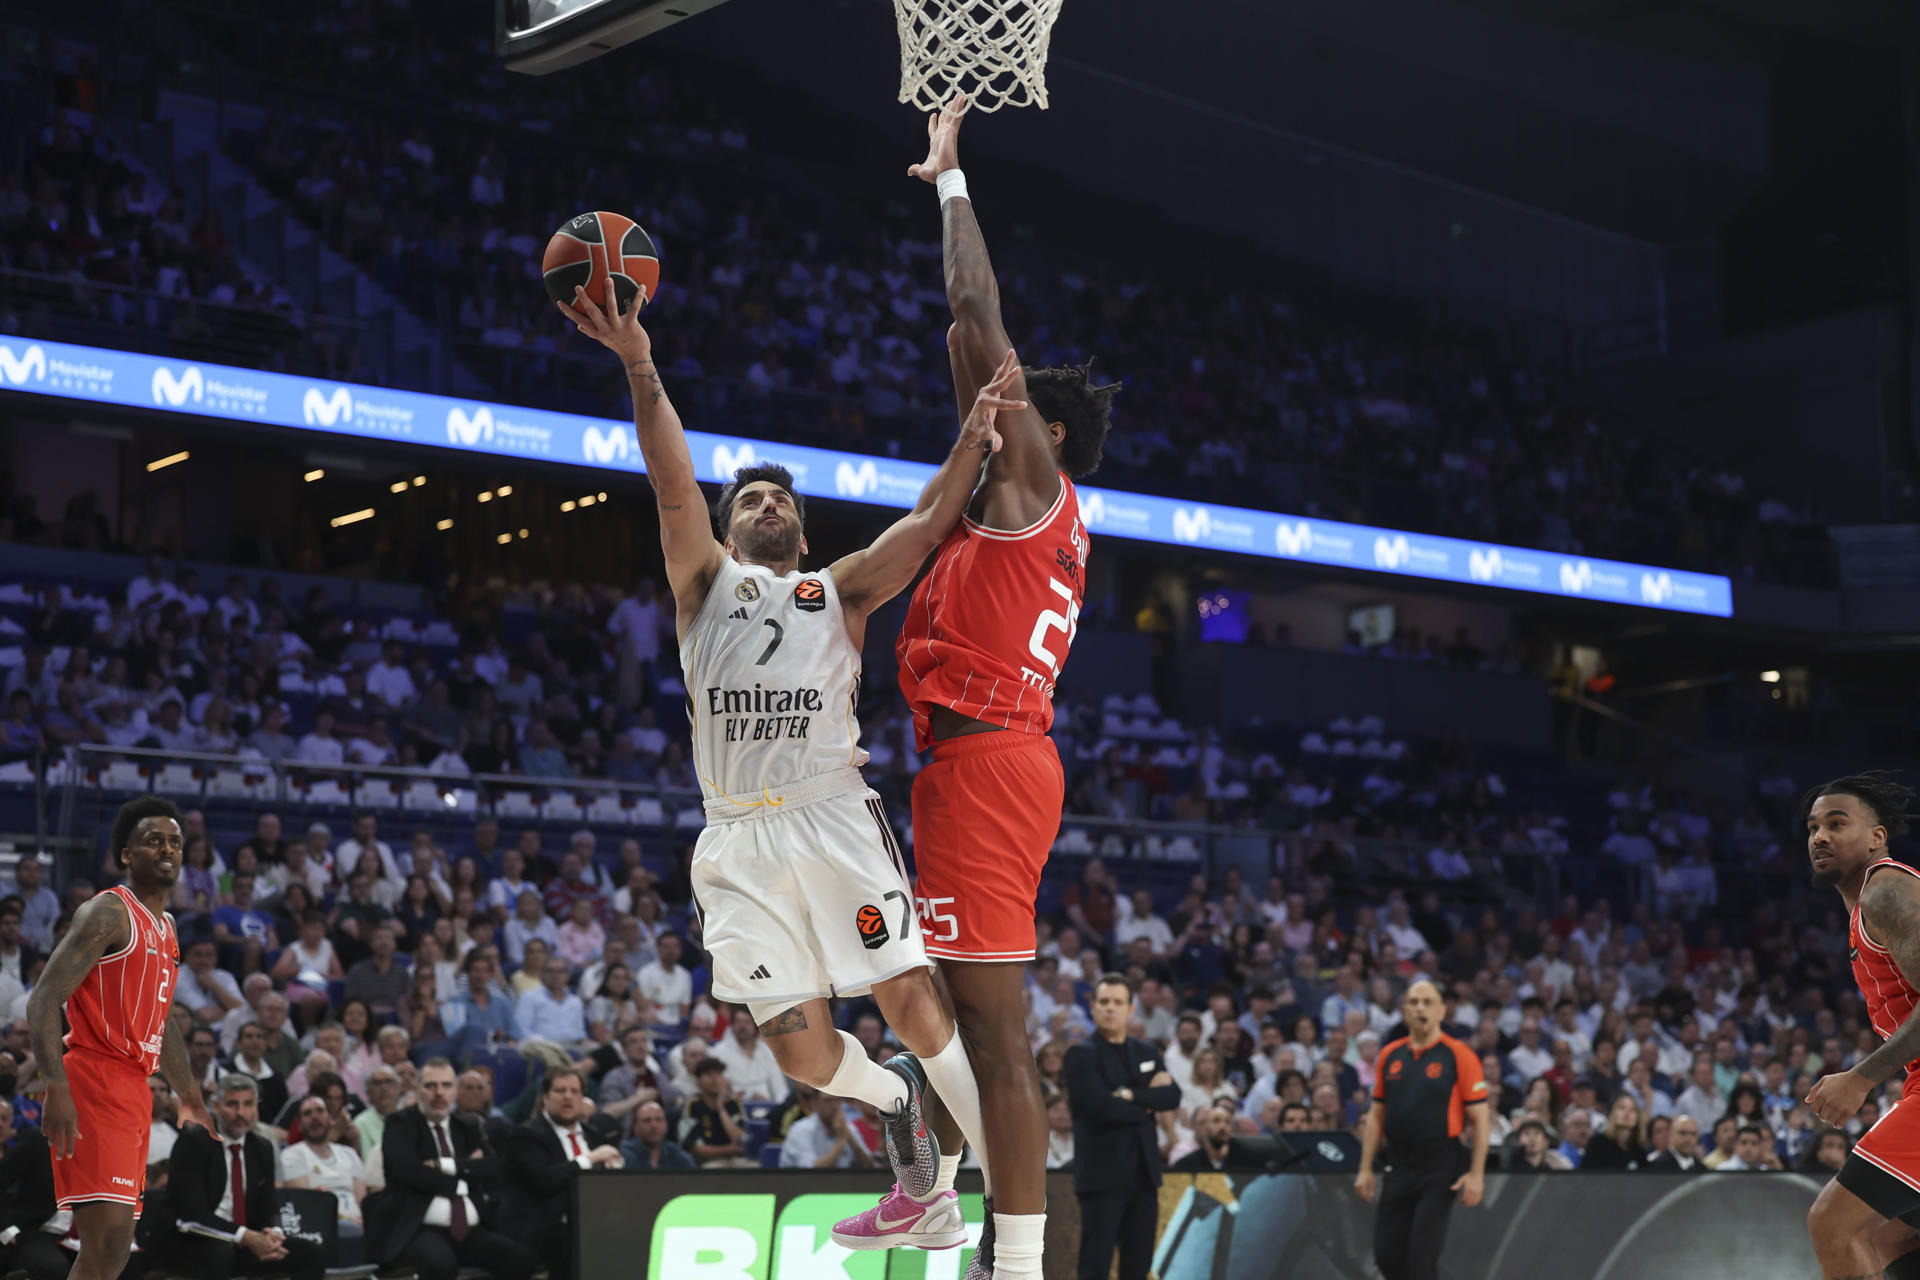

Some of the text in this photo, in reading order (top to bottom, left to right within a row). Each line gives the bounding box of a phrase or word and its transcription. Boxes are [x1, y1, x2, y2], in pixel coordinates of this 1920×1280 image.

[755, 618, 784, 666] 7
[726, 716, 810, 742] FLY BETTER
[883, 889, 910, 941] 7
[158, 968, 169, 1003] 2
